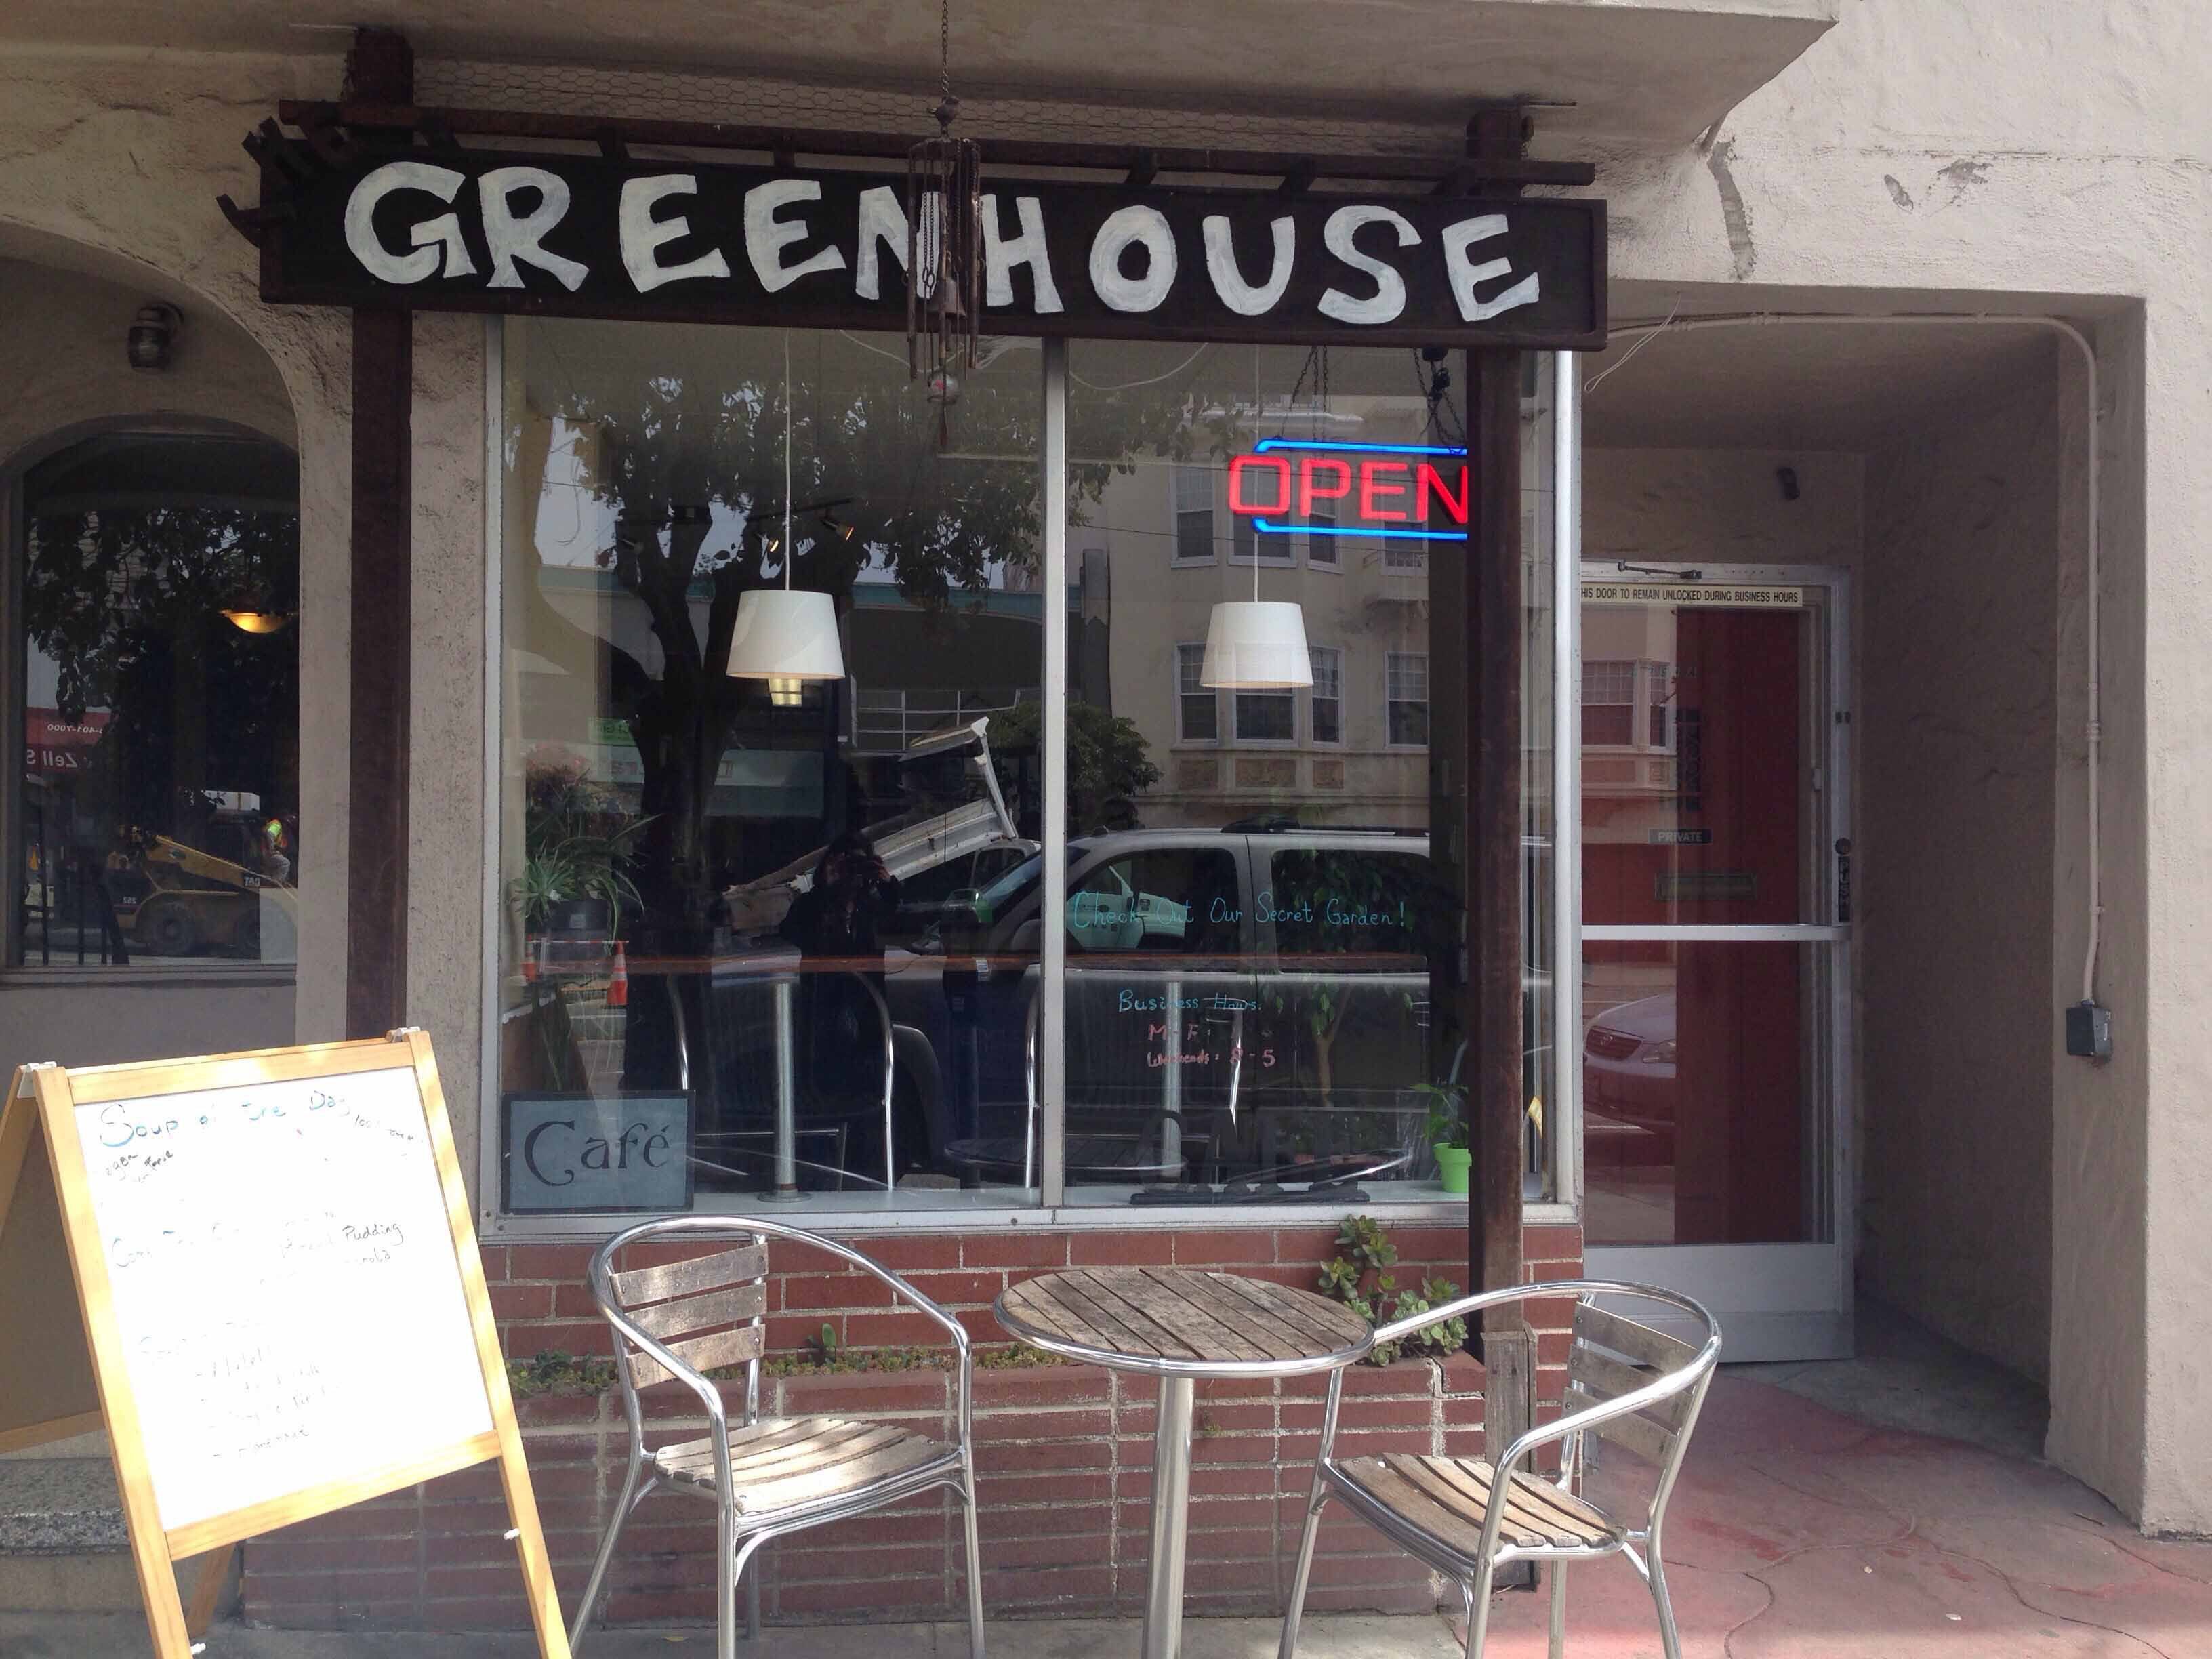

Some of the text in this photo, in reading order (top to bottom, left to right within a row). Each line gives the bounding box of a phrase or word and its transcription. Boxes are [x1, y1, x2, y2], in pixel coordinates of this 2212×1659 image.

[344, 161, 1540, 325] GREENHOUSE
[1228, 455, 1469, 524] OPEN
[1581, 588, 1799, 603] HIS DOOR TO REMAIN UNLOCKED DURING BUSINESS HOURS
[1658, 831, 1703, 842] PRIVATE
[1073, 890, 1141, 928] Check
[1156, 897, 1194, 926] Out
[1210, 897, 1243, 924] Our
[1254, 891, 1313, 924] Secret
[99, 1103, 179, 1148] Soup
[524, 1120, 672, 1187] Café
[342, 1223, 404, 1247] Pudding
